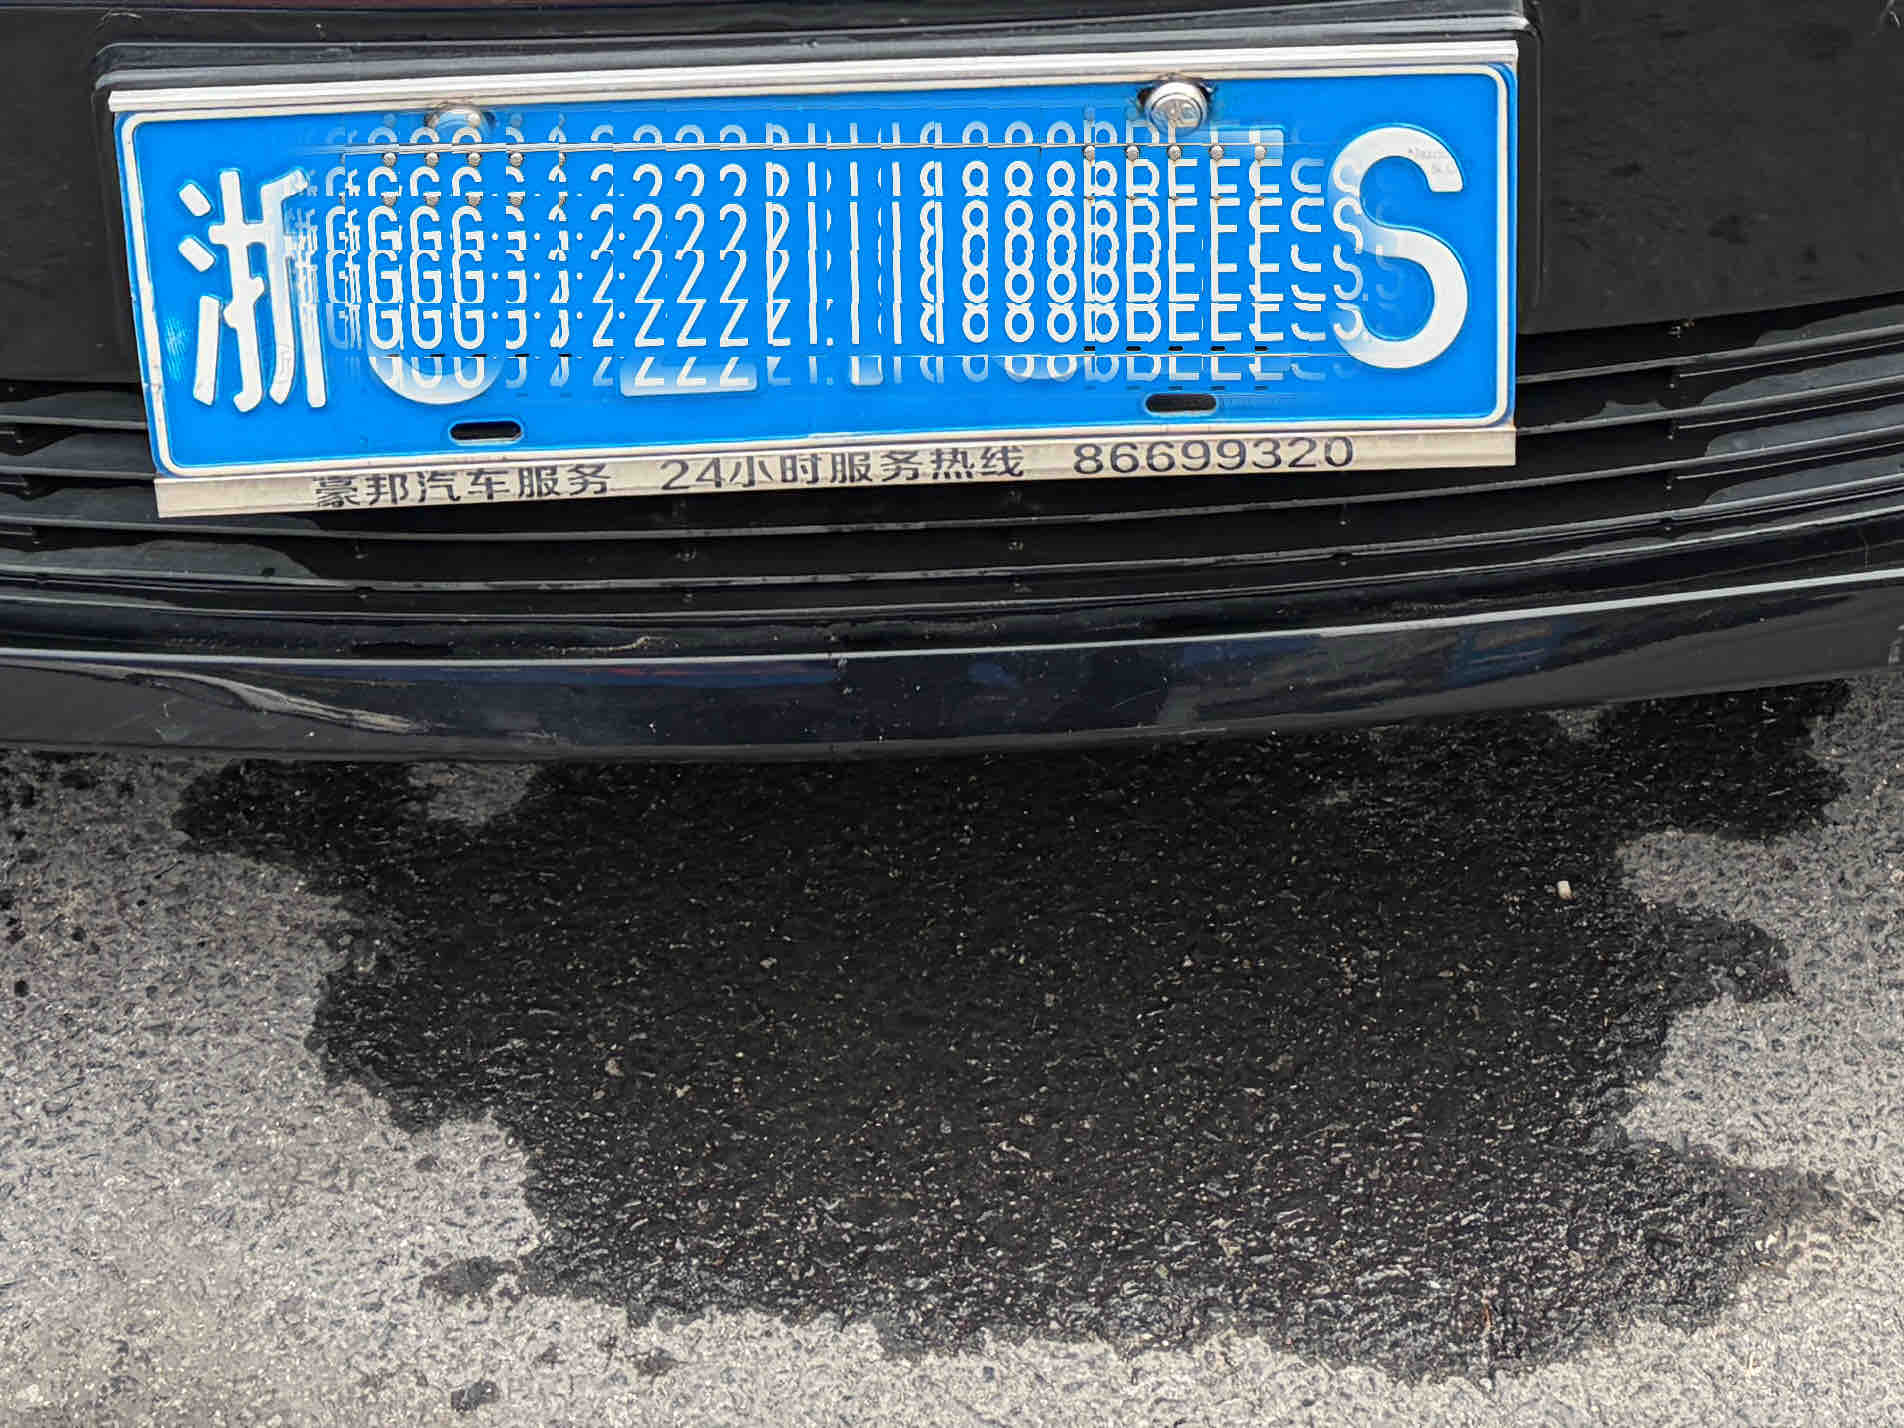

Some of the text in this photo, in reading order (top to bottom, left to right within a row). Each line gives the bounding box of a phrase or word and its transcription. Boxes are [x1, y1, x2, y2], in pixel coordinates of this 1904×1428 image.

[310, 435, 1357, 509] 豪邦汽车服务 24小时服务热线 86699320
